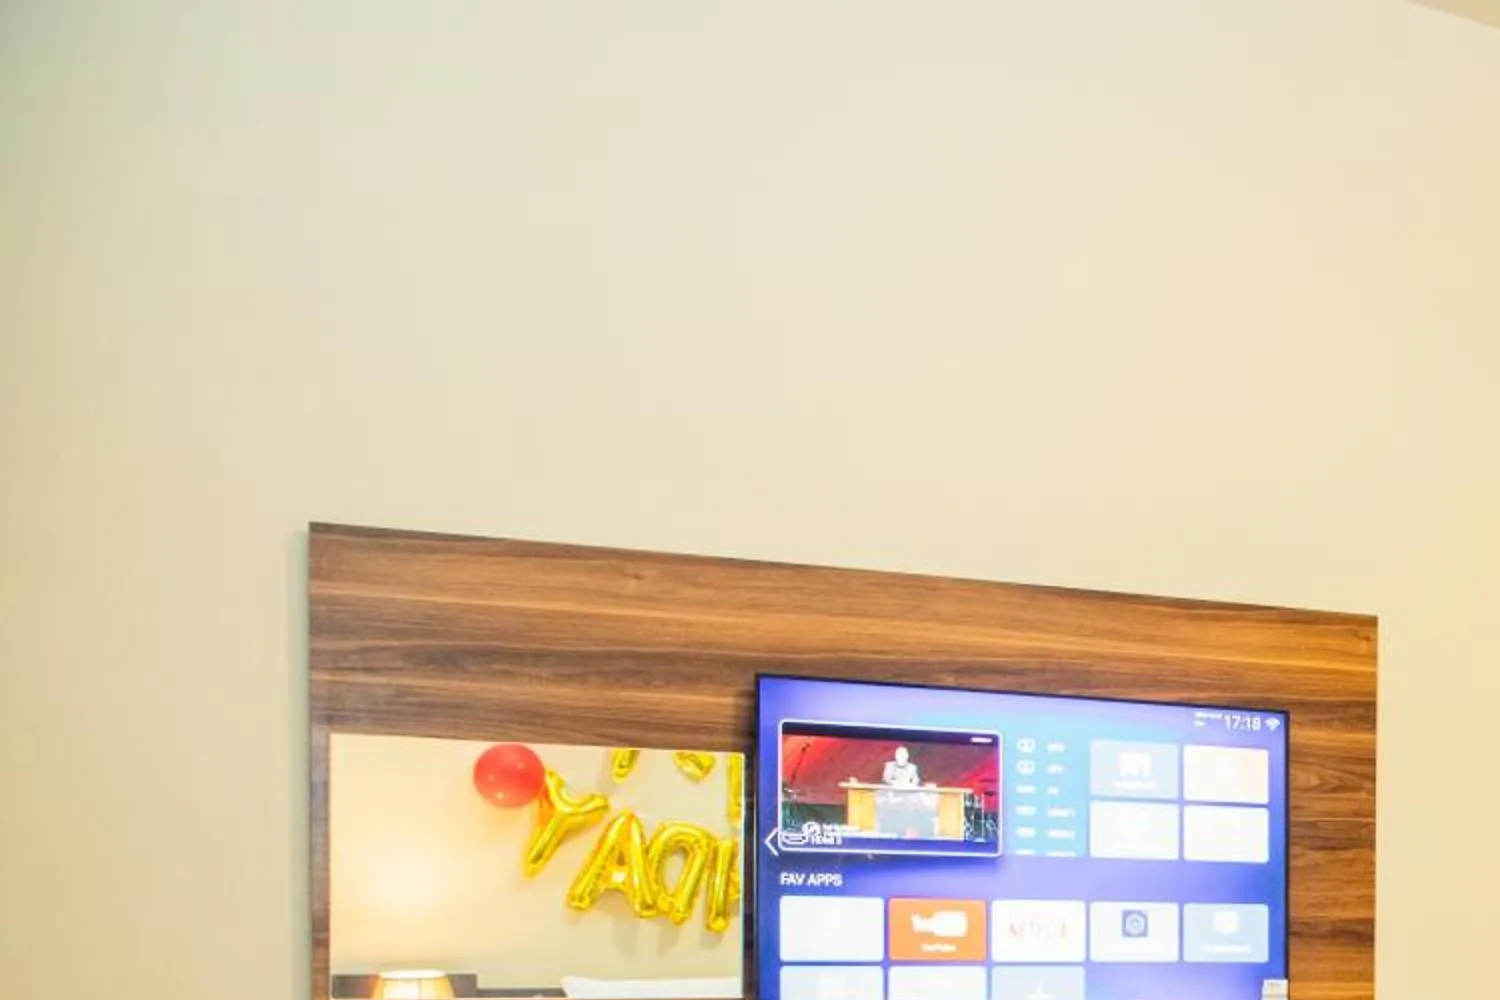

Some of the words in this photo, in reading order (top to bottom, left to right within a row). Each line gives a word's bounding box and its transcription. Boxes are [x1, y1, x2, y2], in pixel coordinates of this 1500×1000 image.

[1224, 714, 1262, 731] 17:18
[780, 872, 805, 886] FAV
[807, 873, 843, 888] APPS
